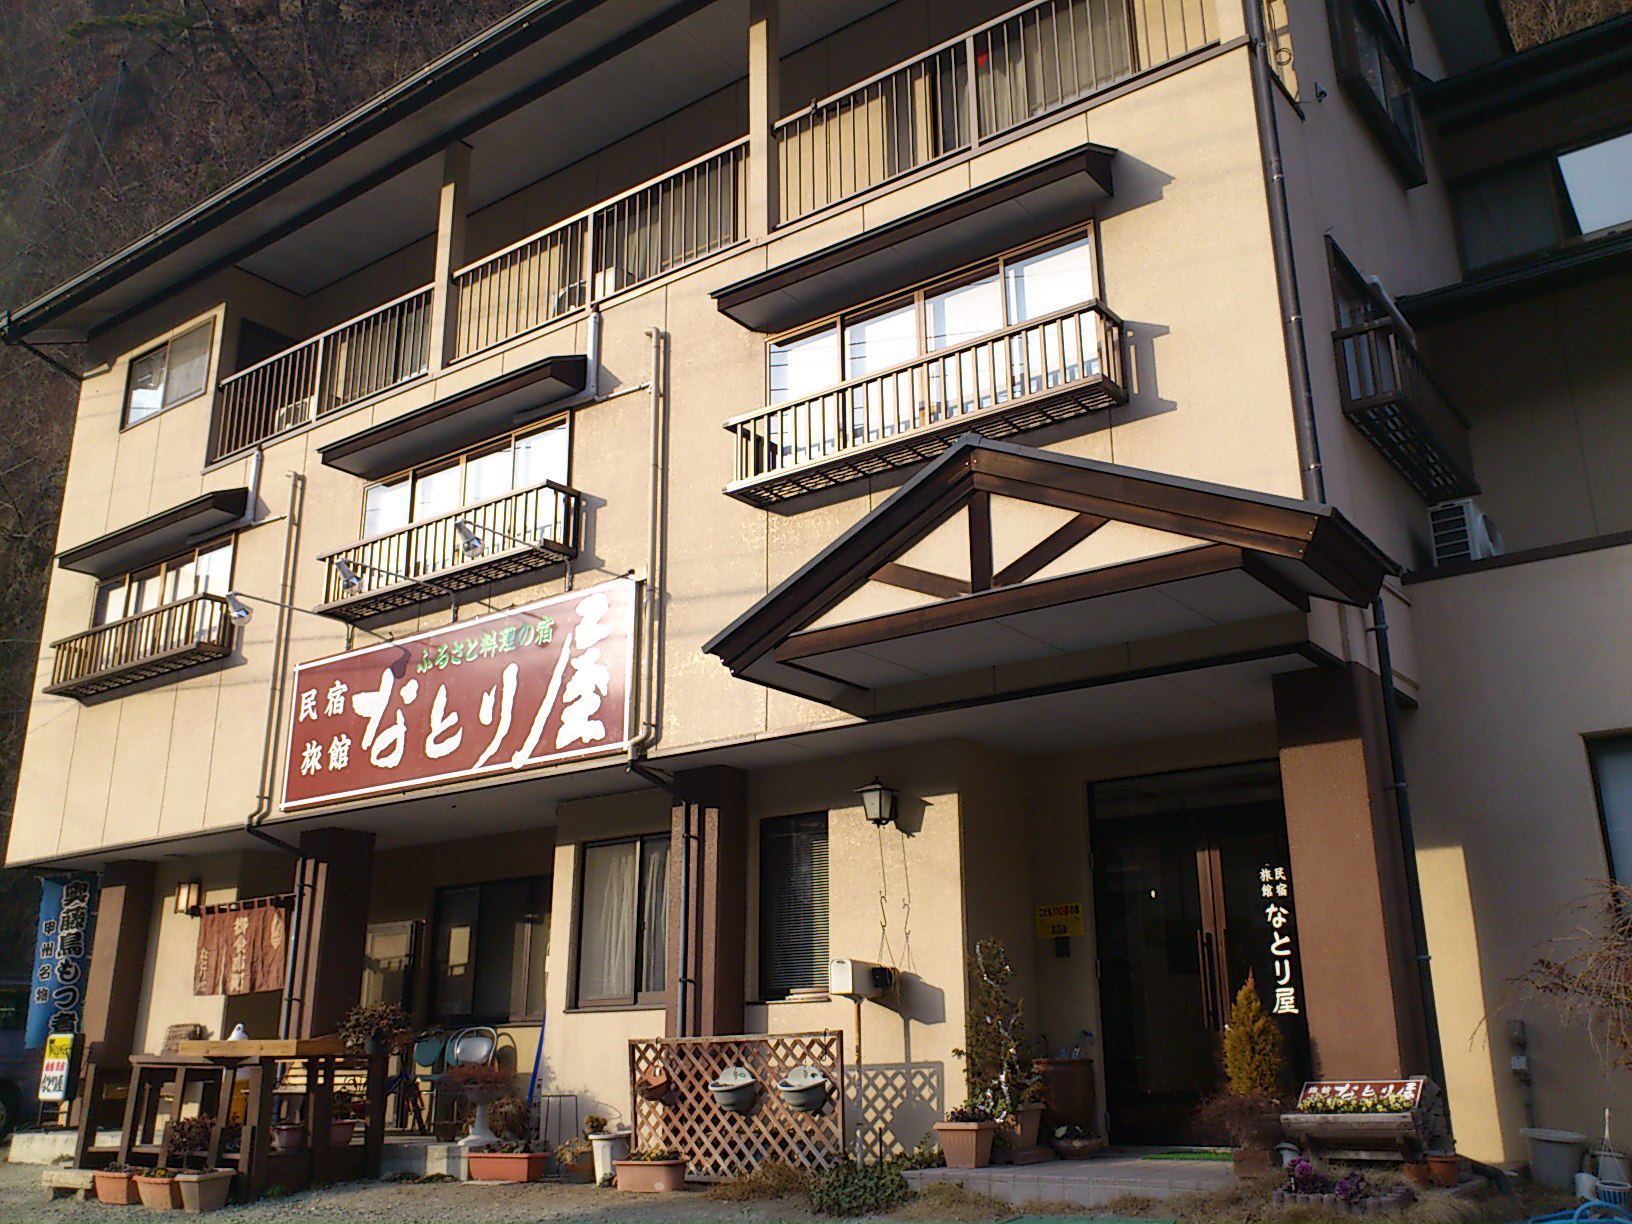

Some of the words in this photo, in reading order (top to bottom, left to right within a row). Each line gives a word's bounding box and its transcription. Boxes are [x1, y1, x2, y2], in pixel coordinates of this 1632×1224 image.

[416, 615, 556, 673] ふるさと料理の宿
[298, 679, 349, 723] 民宿
[353, 593, 610, 769] なとり屋
[300, 735, 352, 776] 旅館
[1259, 867, 1274, 897] 旅館
[1274, 867, 1288, 897] 民宿
[35, 919, 57, 1004] 甲州名物
[1265, 903, 1299, 1015] なとり屋
